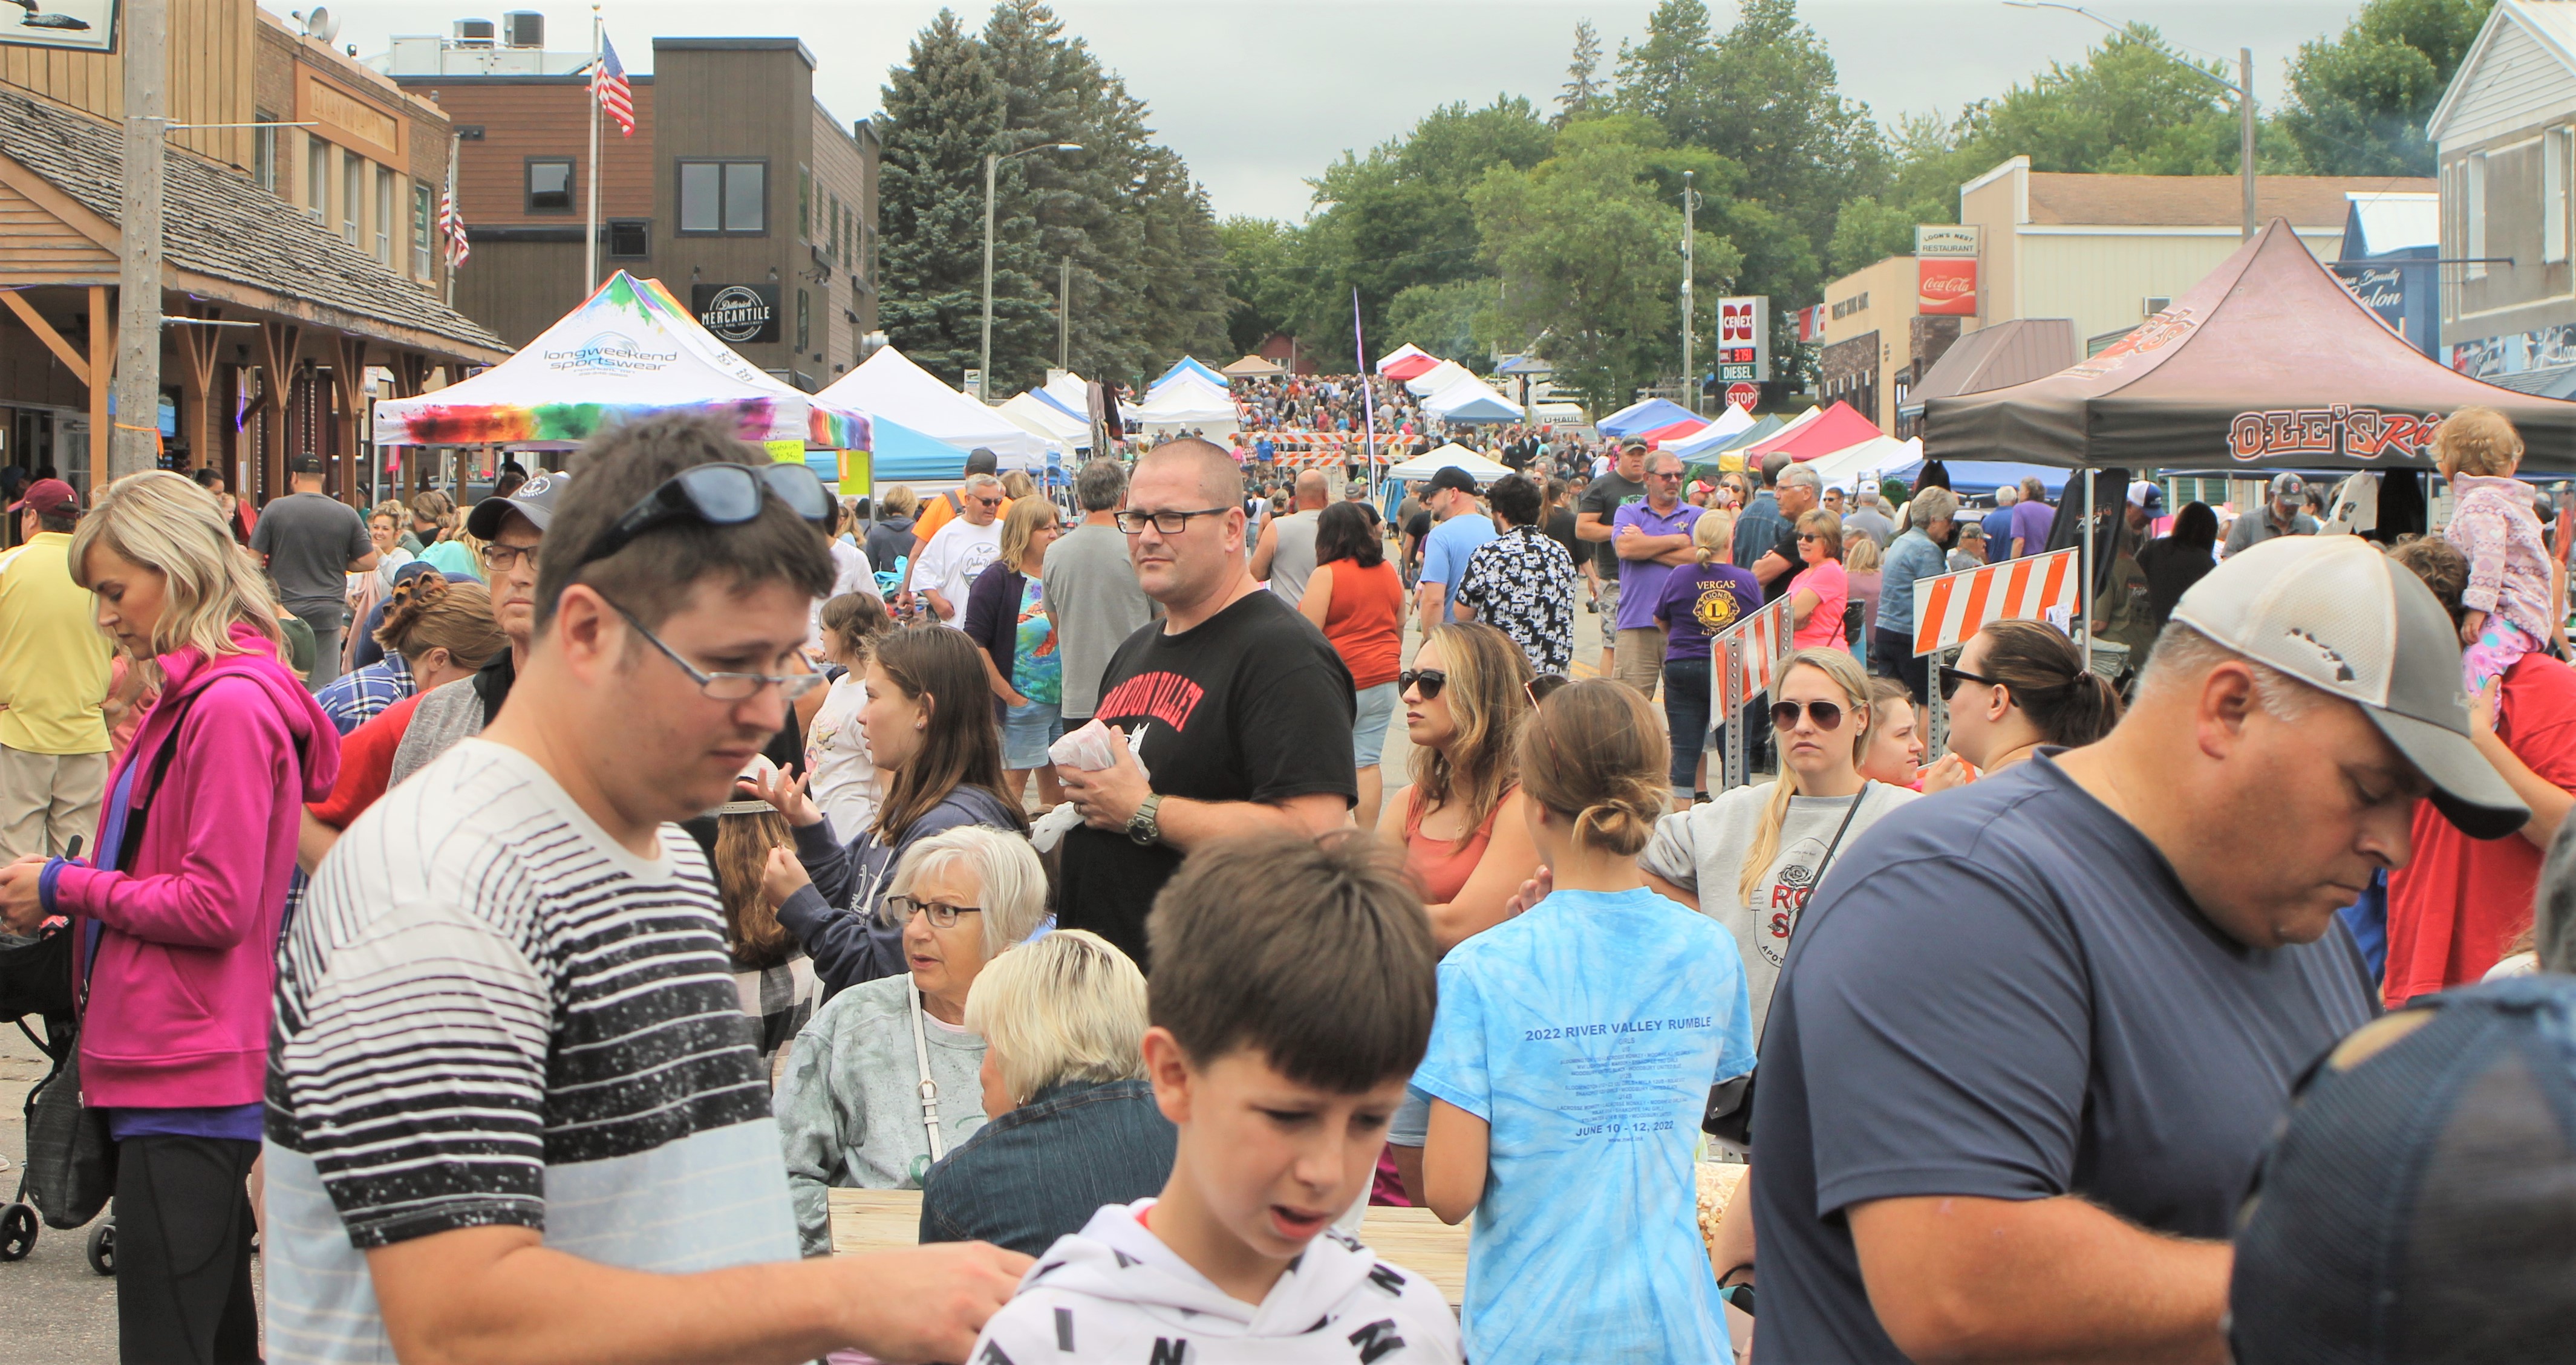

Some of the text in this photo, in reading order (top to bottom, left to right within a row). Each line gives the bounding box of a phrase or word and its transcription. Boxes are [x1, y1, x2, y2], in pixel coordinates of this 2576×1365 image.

[1924, 233, 1974, 242] LOON'S NEST
[2359, 268, 2401, 285] Beauty
[1923, 277, 1973, 292] Coca-Cola
[702, 306, 769, 325] MERCANTILE
[1724, 314, 1752, 329] CENEX
[544, 347, 677, 362] longweekend
[550, 356, 667, 371] sportswear
[1723, 365, 1752, 380] DIESEL
[1727, 392, 1755, 405] STOP
[2228, 403, 2379, 461] OLE'S
[1697, 580, 1736, 590] VERGAS
[1704, 591, 1729, 600] LIONS
[1710, 603, 1723, 617] L
[1148, 671, 1204, 732] VALLEY
[1525, 1017, 1712, 1041] 2022 RIVER VALLEY RUMBLE
[1576, 1125, 1602, 1136] JUNE
[1606, 1124, 1620, 1133] 10
[1632, 1122, 1650, 1133] 12,
[1653, 1121, 1674, 1130] 2022
